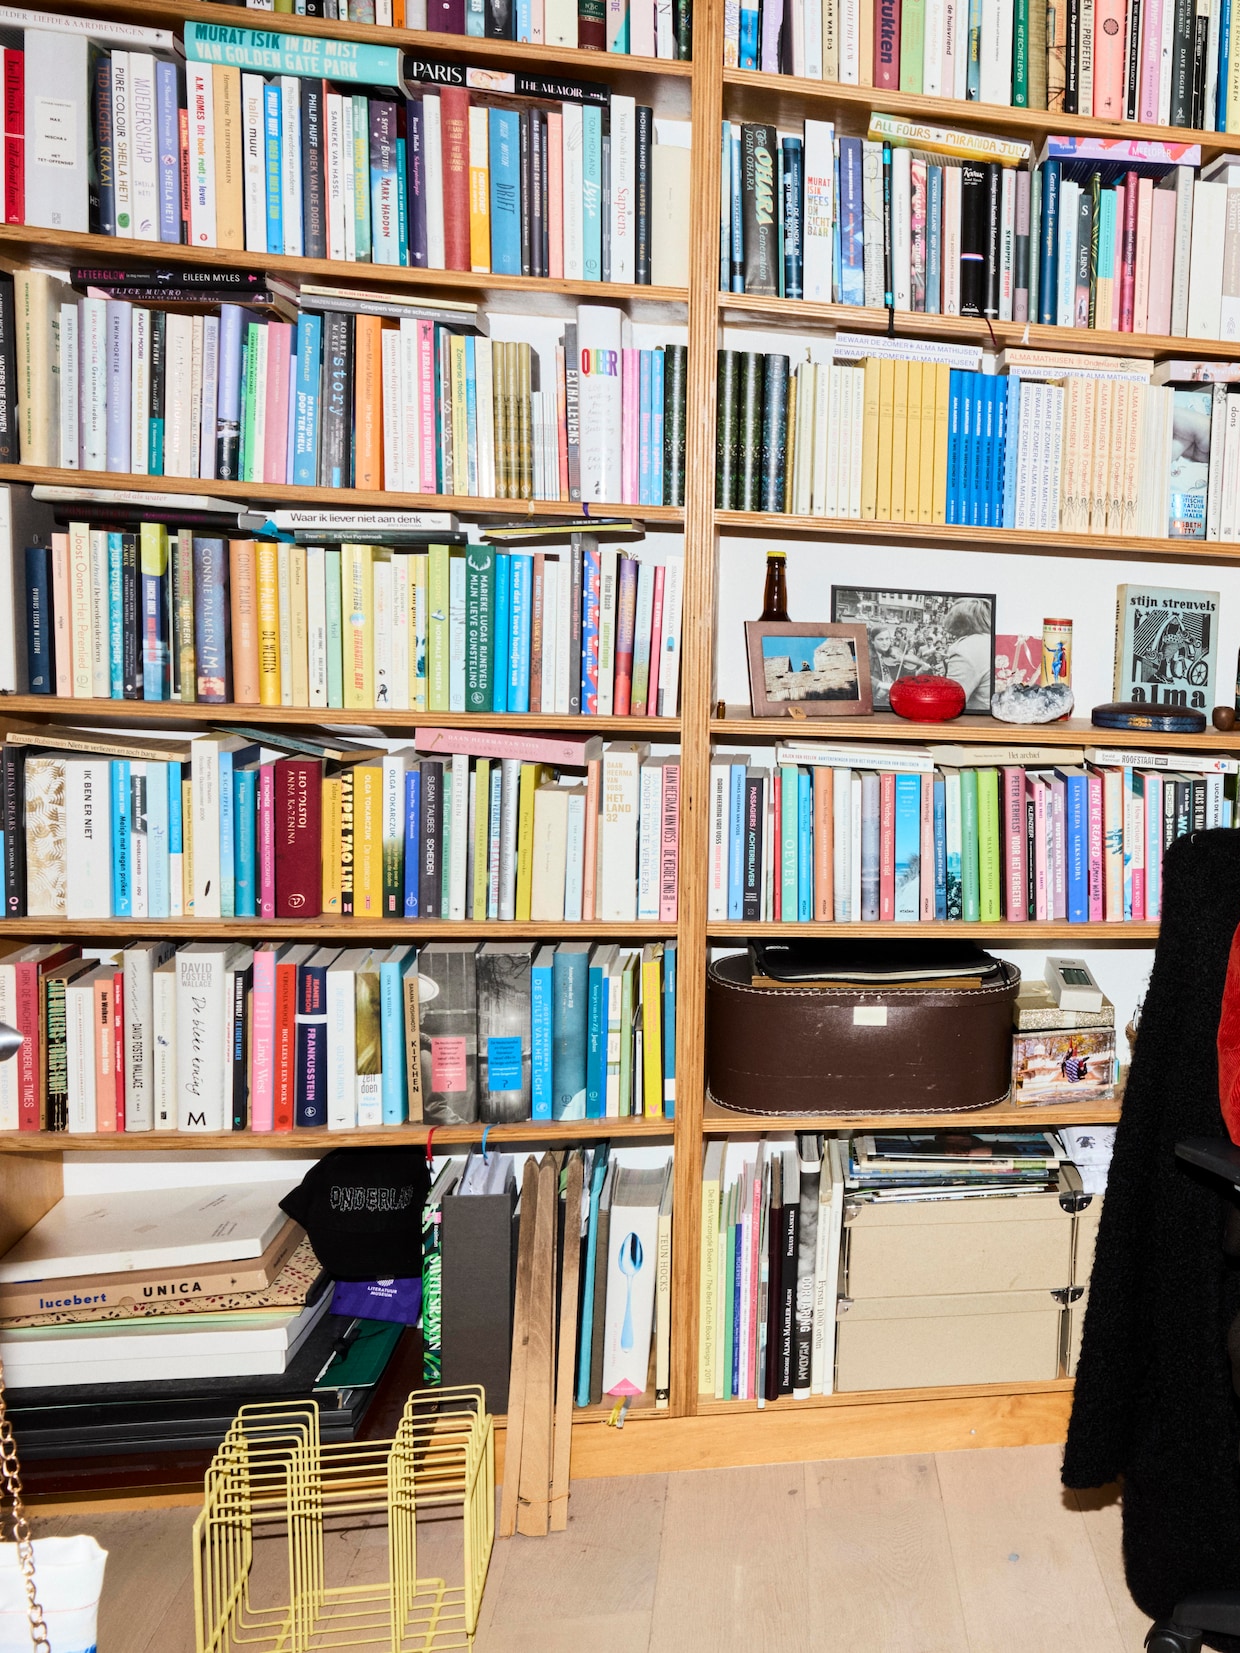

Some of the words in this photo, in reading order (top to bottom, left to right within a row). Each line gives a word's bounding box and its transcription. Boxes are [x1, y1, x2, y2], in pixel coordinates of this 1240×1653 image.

[946, 5, 953, 14] de
[195, 23, 245, 46] MURAT
[251, 29, 280, 49] ISIK
[285, 32, 299, 49] IN
[302, 33, 321, 52] DE
[325, 36, 359, 58] MIST
[945, 16, 953, 55] huisvriend
[1082, 28, 1092, 71] PROFETEN
[194, 42, 222, 63] VAN
[225, 45, 281, 71] GOLDEN
[285, 51, 320, 74] GATE
[324, 56, 359, 78] PARK
[413, 61, 462, 84] PARIS
[115, 67, 125, 92] PURE
[519, 79, 538, 91] THE
[541, 82, 584, 98] MEMOIR
[115, 95, 126, 137] COLOUR
[249, 97, 258, 125] hallo
[308, 94, 317, 122] PHILIP
[249, 127, 258, 157] muur
[309, 124, 318, 147] HUFF
[744, 129, 754, 152] JOHN
[756, 129, 767, 147] The
[874, 120, 894, 134] ALL
[896, 123, 931, 140] FOURS
[945, 132, 996, 152] MIRANDA
[998, 141, 1028, 158] JULY
[117, 142, 127, 176] SHEILA
[310, 149, 318, 172] BOEK
[745, 154, 754, 191] O'HARA
[119, 180, 128, 202] HETI
[310, 174, 319, 191] VAN
[755, 147, 774, 225] O'HARA
[311, 193, 319, 205] DE
[495, 183, 516, 215] DRIFT
[614, 186, 630, 236] Sapiens
[311, 206, 320, 236] DODEN
[758, 226, 769, 280] Generation
[1079, 245, 1089, 278] ALBINO
[77, 269, 125, 281] AFTERGLOW
[182, 273, 212, 282] EILEEN
[213, 274, 241, 282] MYLES
[837, 335, 871, 346] BEWAAR
[873, 338, 884, 347] DE
[885, 339, 909, 350] ZOMER
[915, 342, 936, 352] ALMA
[937, 344, 979, 357] MATHIJSEN
[456, 348, 464, 378] Zomerse
[1009, 353, 1031, 363] ALMA
[1031, 354, 1075, 365] MATHIJSEN
[1083, 358, 1120, 369] Onderland
[329, 356, 348, 417] story
[567, 370, 578, 404] EXTRA
[567, 406, 579, 445] LEVENS
[290, 512, 316, 524] Waar
[318, 513, 328, 524] ik
[329, 513, 356, 524] liever
[358, 514, 376, 524] niet
[378, 516, 396, 524] aan
[397, 514, 422, 525] denk
[202, 548, 212, 594] CONNIE
[470, 574, 478, 598] MIJN
[480, 575, 488, 612] MARIEKE
[470, 601, 478, 627] LIEVE
[1130, 596, 1158, 608] stijn
[1163, 598, 1216, 612] streuvels
[203, 598, 213, 643] PALMEN
[480, 615, 488, 642] LUCAS
[263, 631, 275, 642] DE
[202, 646, 218, 674] I.M.
[263, 644, 276, 673] WETTEN
[469, 630, 477, 688] GUNSTELING
[479, 645, 488, 689] RIJNEVELD
[1131, 684, 1207, 708] alma
[84, 770, 92, 780] IK
[287, 771, 295, 796] ANNA
[427, 776, 435, 802] SUSAN
[84, 782, 92, 801] BEN
[1092, 785, 1100, 805] MEN
[84, 804, 92, 816] ER
[287, 799, 295, 844] KARENINA
[298, 790, 306, 828] TOLSTOJ
[427, 805, 435, 833] TAUBES
[1092, 808, 1099, 822] WE
[84, 819, 93, 840] NIET
[1091, 824, 1099, 857] REAPED
[426, 838, 434, 875] SCHEIDEN
[748, 832, 756, 887] ACHTERBLIJVERS
[784, 839, 795, 887] OEVER
[191, 997, 206, 1013] De
[132, 1023, 142, 1040] DAVID
[191, 1019, 206, 1054] bleke
[132, 1042, 142, 1062] FOSTER
[306, 1028, 316, 1100] FRANKUSSTEIN
[133, 1064, 142, 1089] WALLACE
[185, 1058, 205, 1096] koning
[411, 1040, 419, 1093] KITCHEN
[660, 1234, 668, 1258] TEUN
[143, 1280, 203, 1298] UNICA
[367, 1286, 398, 1294] LITERATUUR
[659, 1261, 668, 1292] HOCKS
[39, 1293, 107, 1309] lucebert
